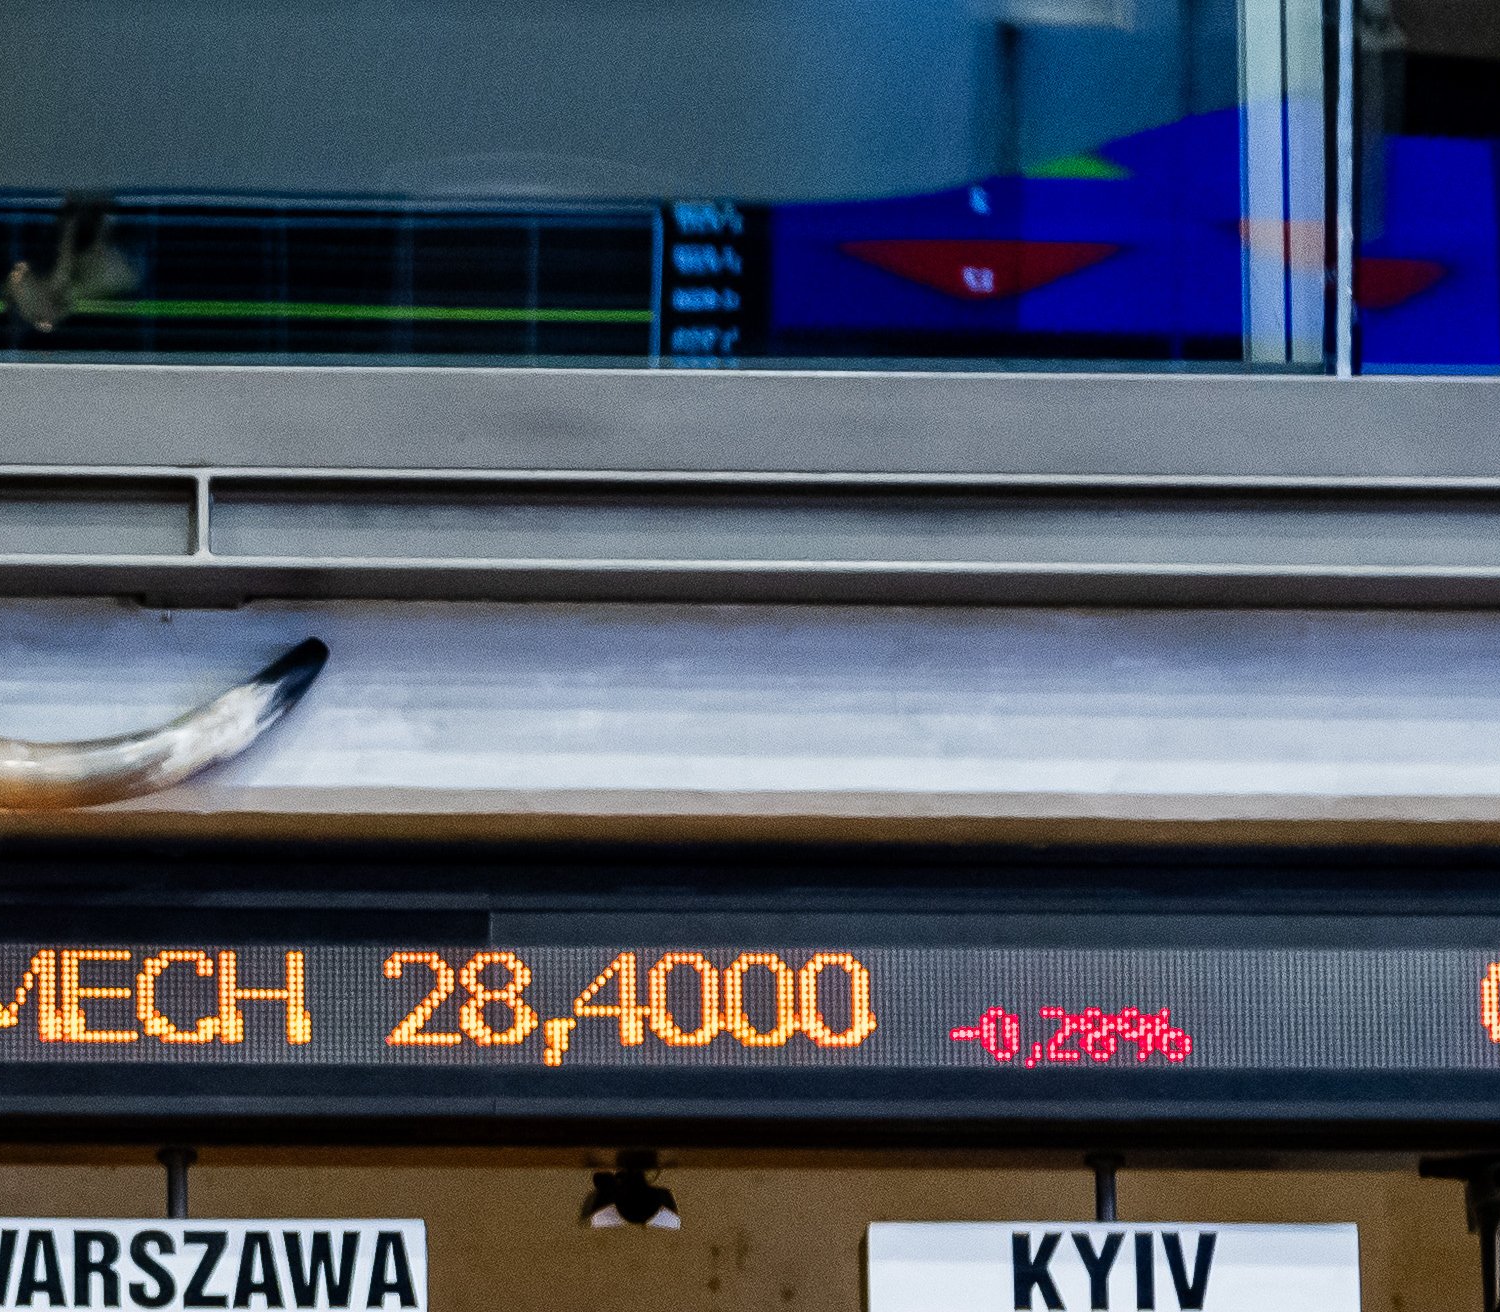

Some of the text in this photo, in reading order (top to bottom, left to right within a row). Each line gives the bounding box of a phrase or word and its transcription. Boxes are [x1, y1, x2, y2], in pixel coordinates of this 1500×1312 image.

[384, 952, 877, 1066] 28,4000
[950, 1007, 1192, 1068] -0,28%
[1012, 1233, 1216, 1310] KYIV
